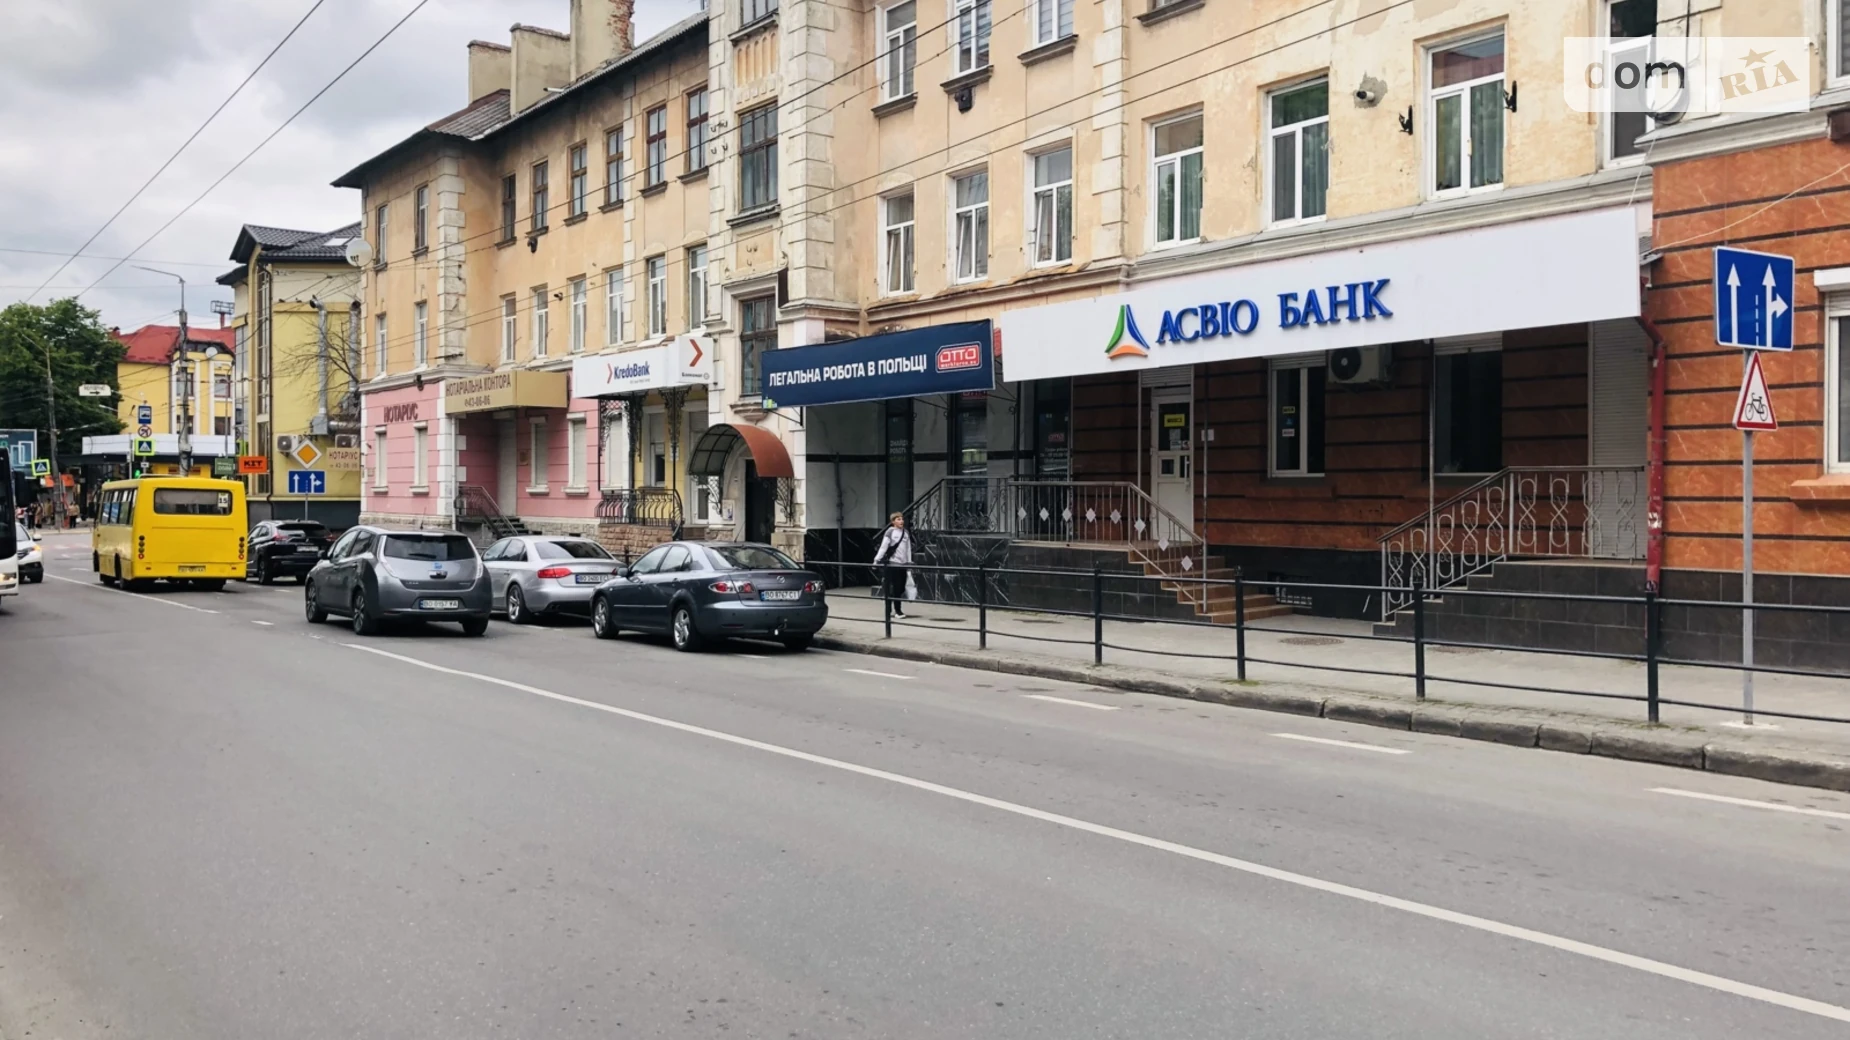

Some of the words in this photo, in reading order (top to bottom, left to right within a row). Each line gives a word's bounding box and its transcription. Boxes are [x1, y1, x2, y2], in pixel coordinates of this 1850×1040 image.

[1156, 299, 1259, 345] АСВІО
[1277, 279, 1393, 329] БАНК
[940, 347, 977, 362] OTTO
[614, 361, 650, 380] KredoBank
[769, 368, 821, 387] ЛЕГАЛЬНА
[823, 362, 866, 381] РОБОТА
[867, 361, 876, 376] В
[878, 354, 927, 376] ПОЛЬЩІ
[484, 374, 512, 392] КОНТОРА
